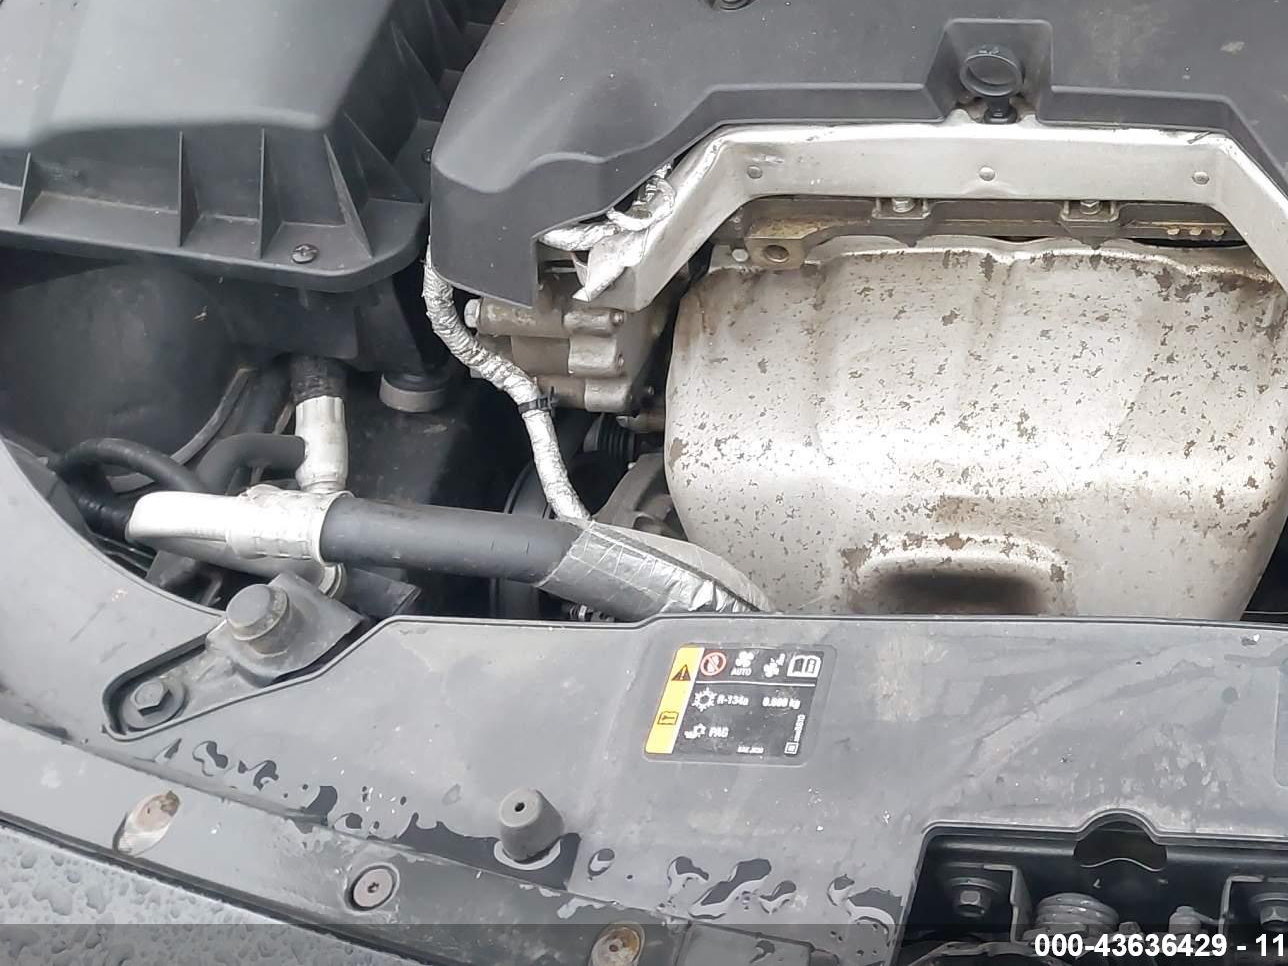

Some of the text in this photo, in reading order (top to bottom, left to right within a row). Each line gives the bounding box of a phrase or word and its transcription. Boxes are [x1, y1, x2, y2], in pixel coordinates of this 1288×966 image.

[731, 667, 752, 676] AUTO
[717, 694, 749, 706] R-134a
[788, 698, 801, 710] kg
